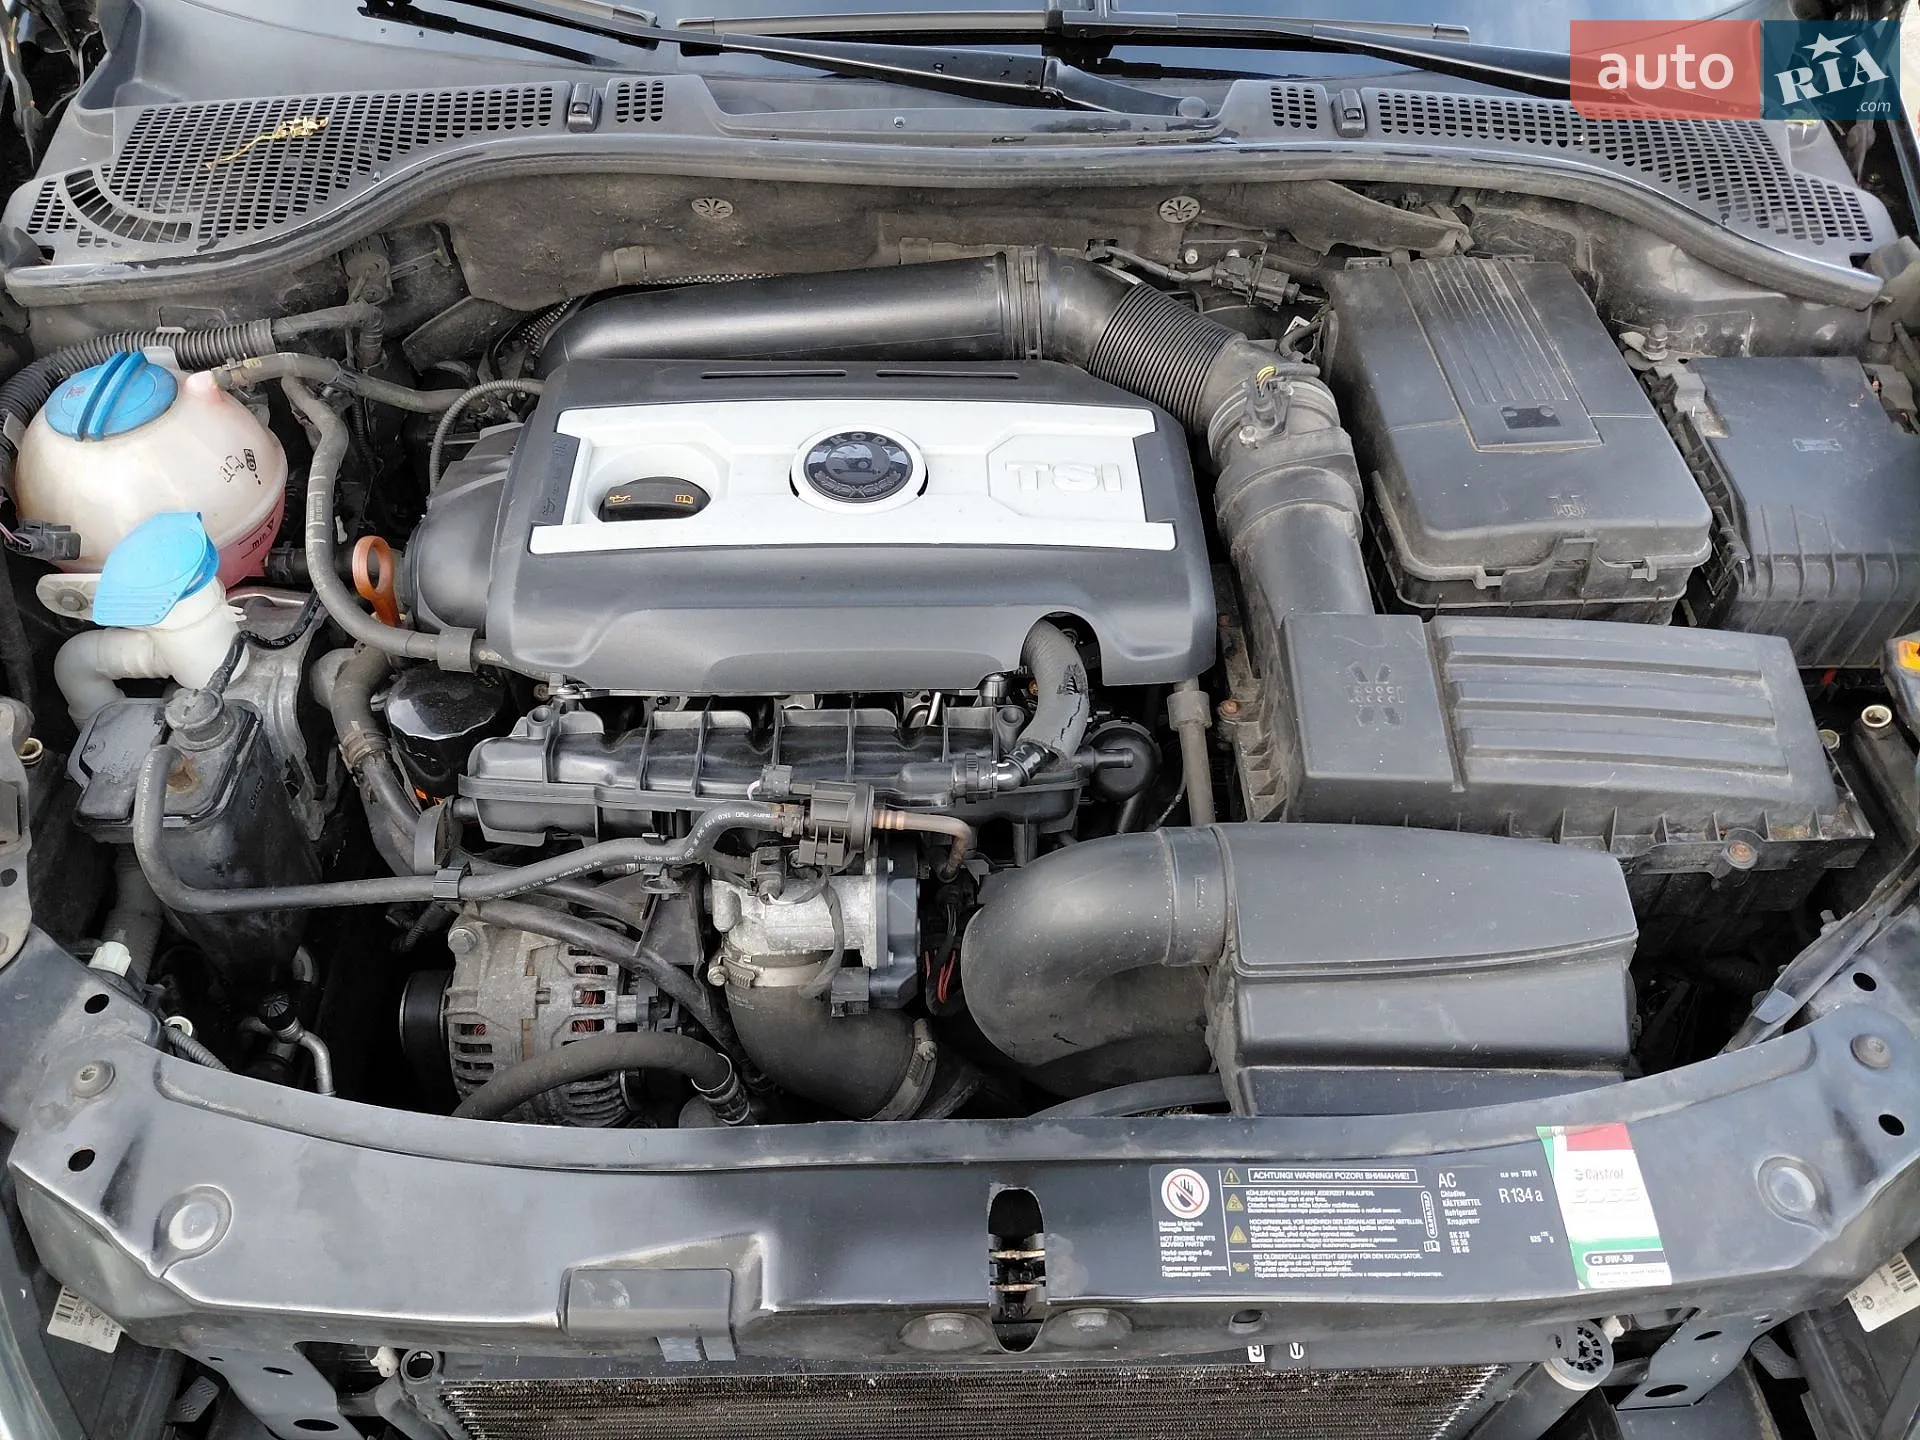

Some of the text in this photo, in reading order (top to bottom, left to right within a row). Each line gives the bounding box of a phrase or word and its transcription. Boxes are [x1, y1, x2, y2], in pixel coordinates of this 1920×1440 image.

[1004, 460, 1123, 492] TSI
[1438, 1172, 1457, 1188] AC
[1585, 1168, 1625, 1181] Castrol
[1498, 1187, 1544, 1203] R 134 a
